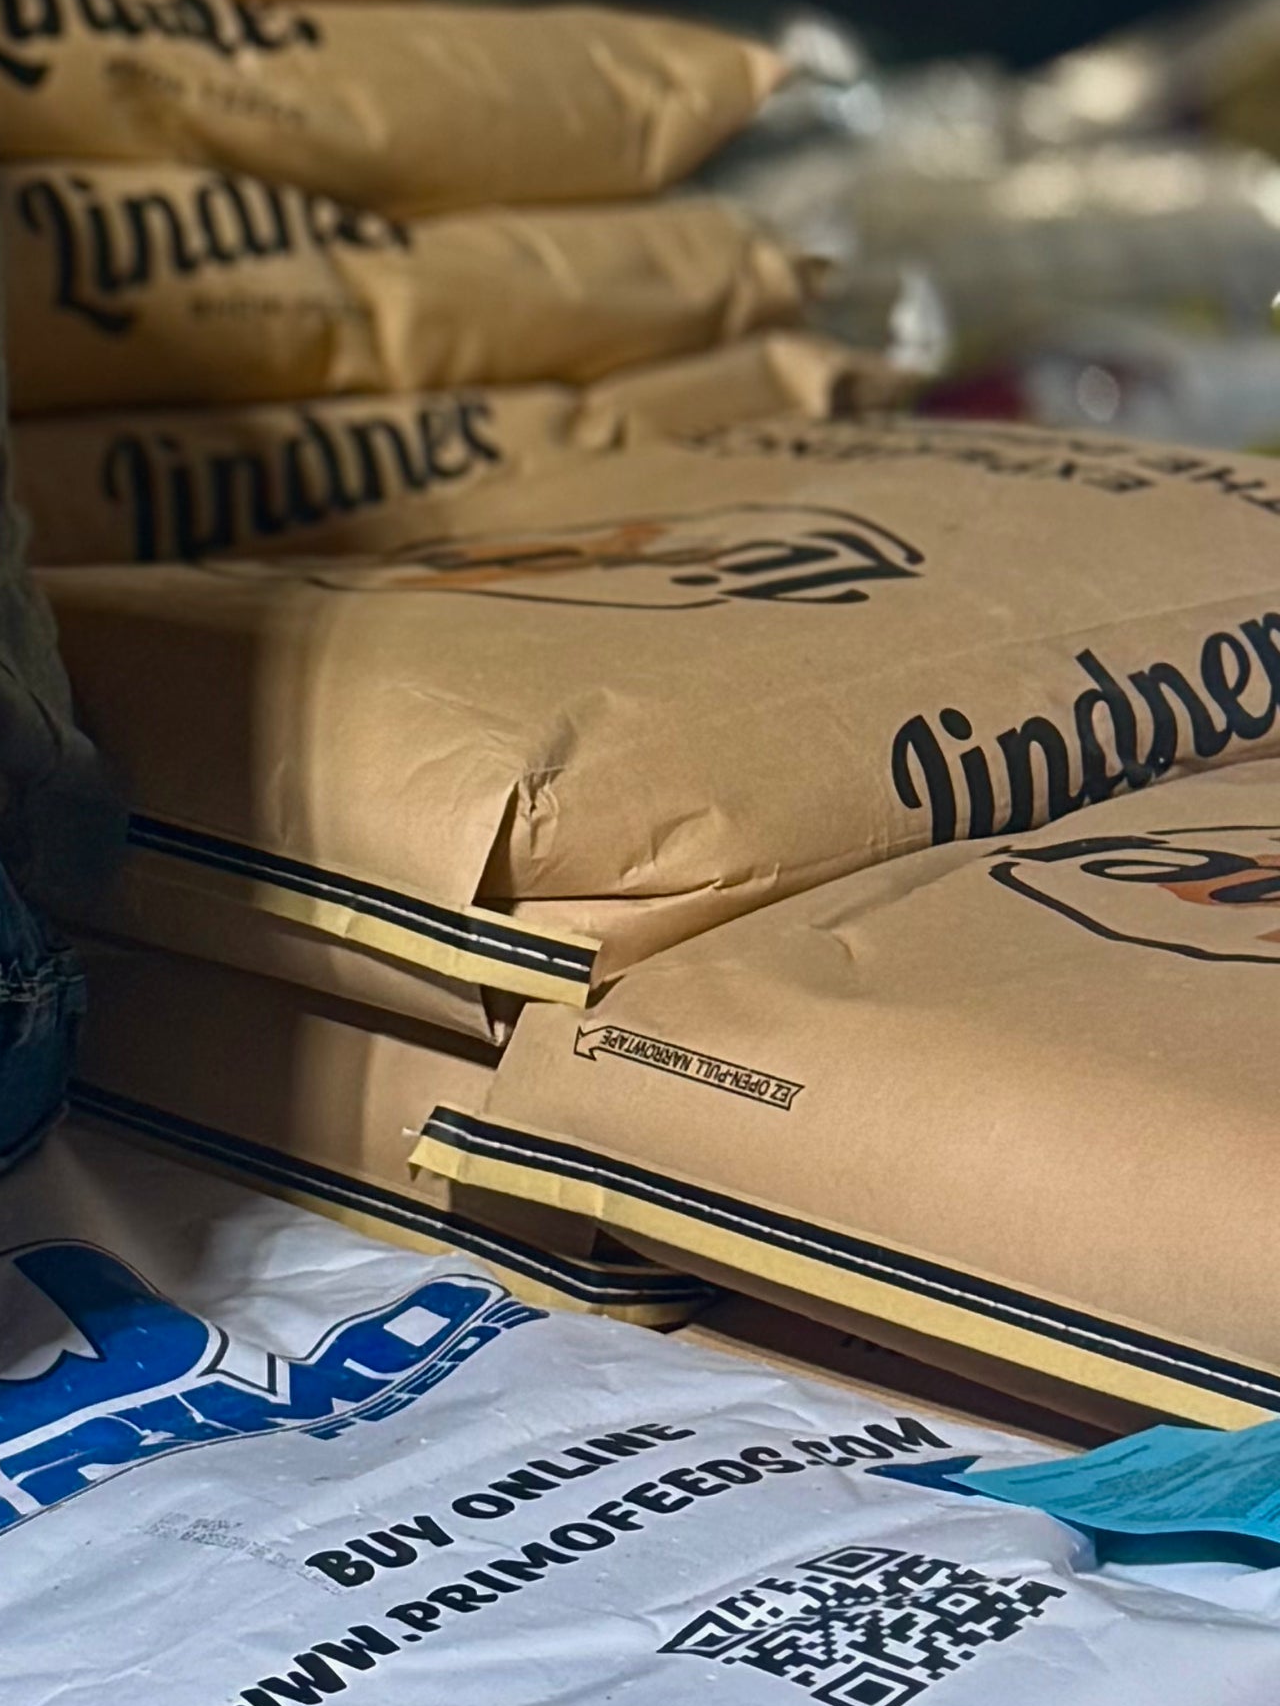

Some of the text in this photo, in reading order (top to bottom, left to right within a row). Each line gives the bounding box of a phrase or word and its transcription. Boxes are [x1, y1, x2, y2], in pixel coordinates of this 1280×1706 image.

[696, 1057, 771, 1097] OPEN-PULL
[770, 1083, 792, 1103] EZ
[298, 1300, 551, 1441] FEEDS
[303, 1513, 455, 1589] BUY
[450, 1422, 697, 1521] ONLINE
